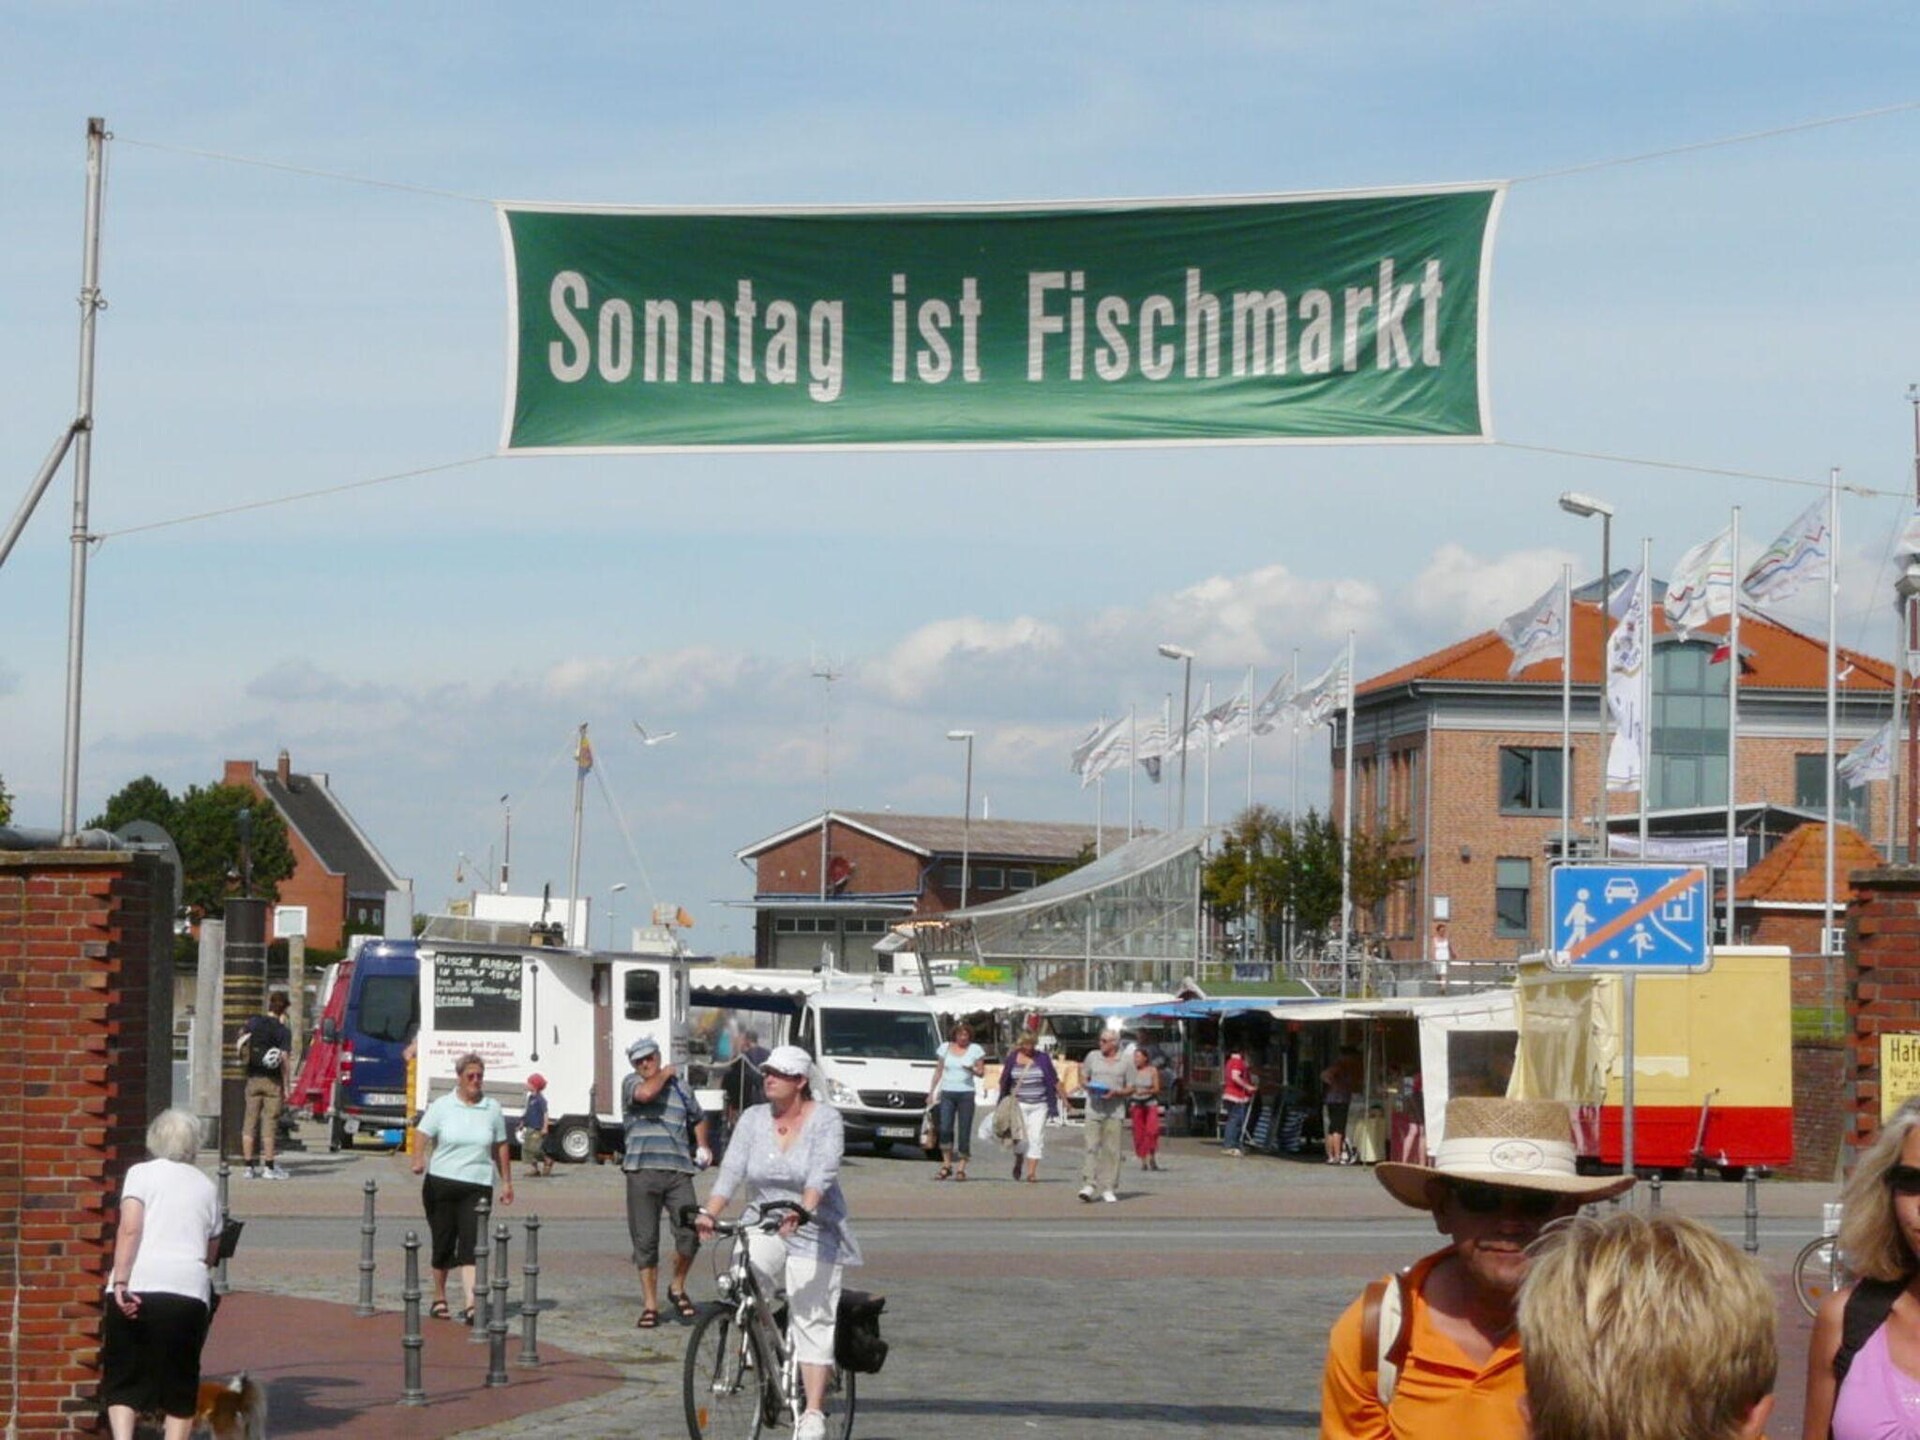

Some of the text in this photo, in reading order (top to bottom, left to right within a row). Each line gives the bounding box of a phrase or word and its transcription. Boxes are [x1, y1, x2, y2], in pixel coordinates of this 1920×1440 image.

[549, 258, 1443, 402] Sonntag ist Fischmarkt
[1890, 1037, 1920, 1063] Haf
